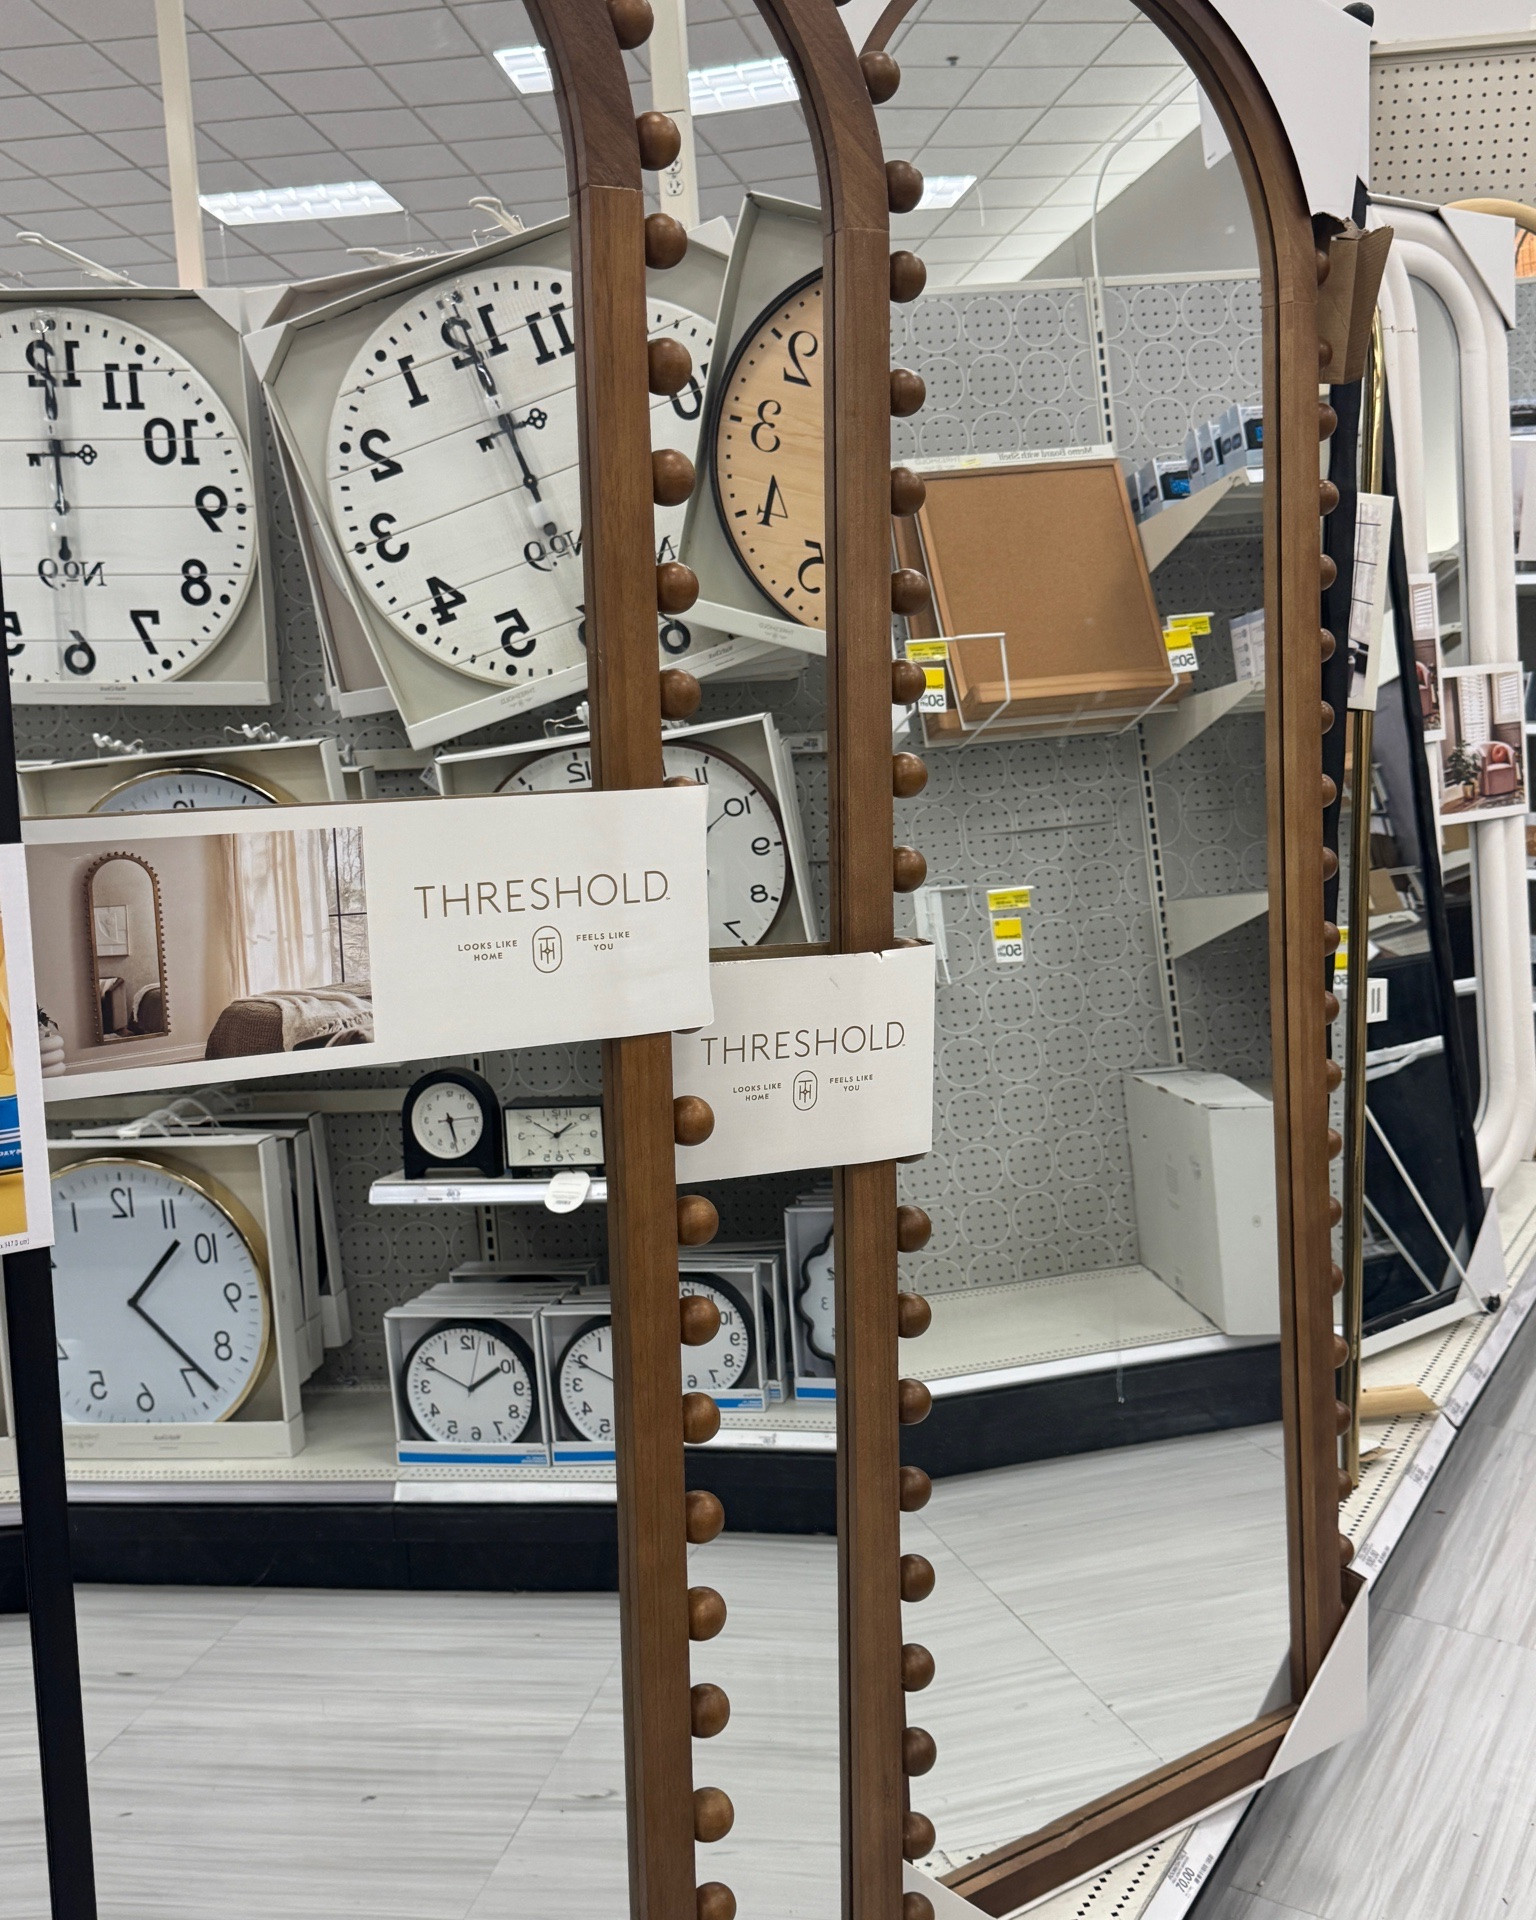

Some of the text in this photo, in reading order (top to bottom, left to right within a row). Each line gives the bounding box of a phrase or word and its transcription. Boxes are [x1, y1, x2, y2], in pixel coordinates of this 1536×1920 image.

[413, 870, 668, 919] THRESHOLD
[576, 930, 631, 942] FEELS LIKE
[457, 939, 518, 952] LOOKS LIKE
[593, 942, 614, 951] YOU
[473, 952, 504, 962] HOME
[701, 1021, 905, 1066] THRESHOLD
[829, 1073, 874, 1084] FEELS LIKE
[732, 1082, 782, 1094] LOOKS LIKE
[843, 1084, 860, 1092] YOU
[745, 1093, 770, 1102] HOME
[1175, 1867, 1195, 1893] 70.00
